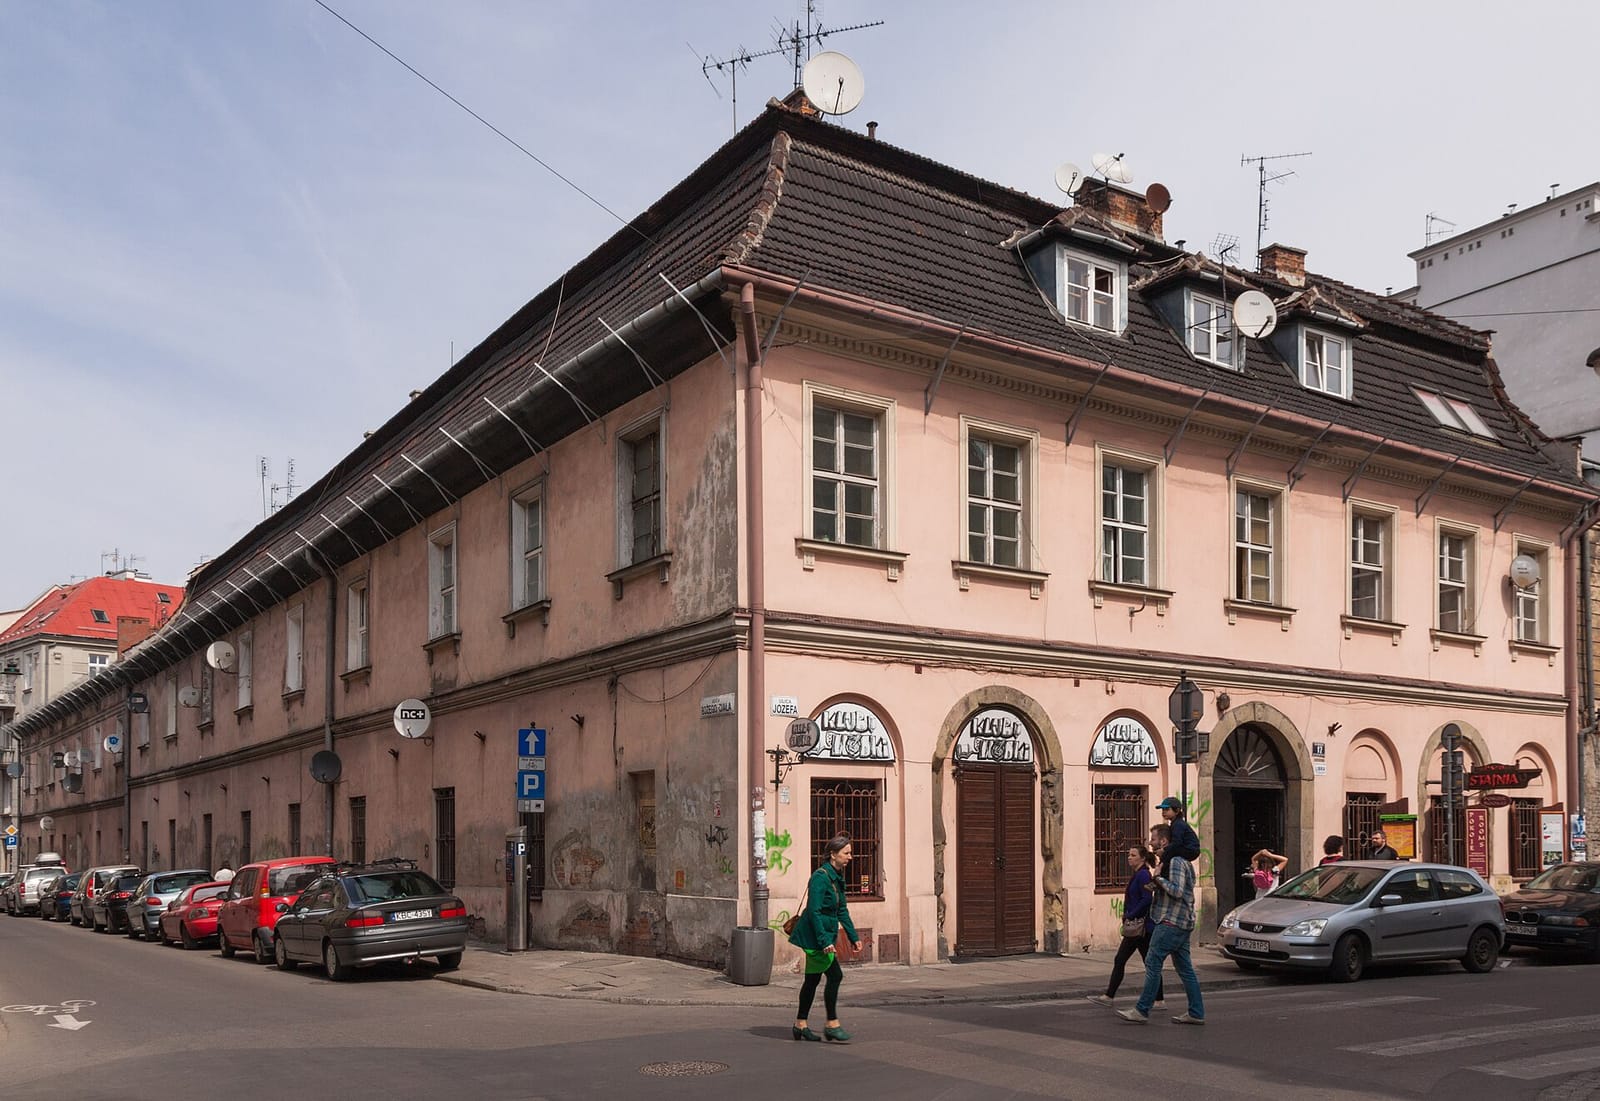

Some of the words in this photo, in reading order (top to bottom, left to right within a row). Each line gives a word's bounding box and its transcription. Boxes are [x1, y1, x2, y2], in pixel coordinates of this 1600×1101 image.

[402, 710, 424, 718] nc+
[523, 774, 539, 796] P
[518, 843, 526, 855] P
